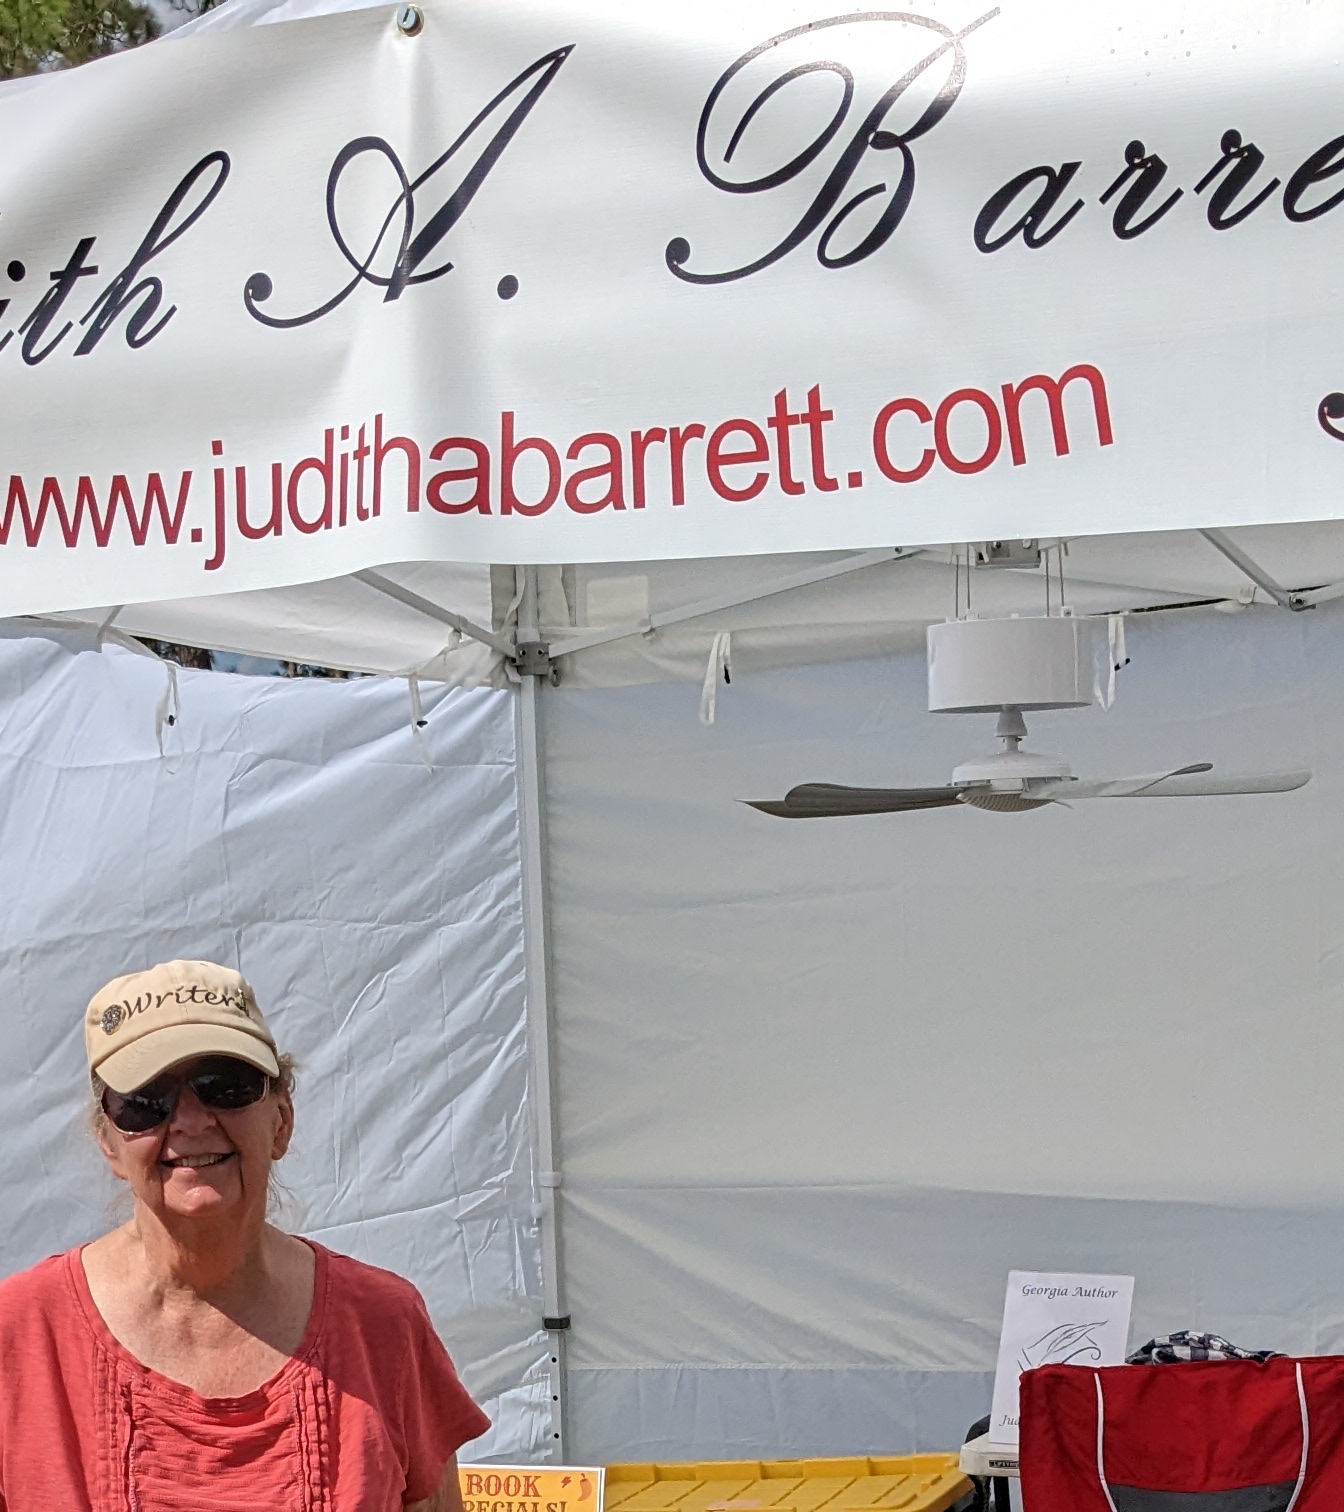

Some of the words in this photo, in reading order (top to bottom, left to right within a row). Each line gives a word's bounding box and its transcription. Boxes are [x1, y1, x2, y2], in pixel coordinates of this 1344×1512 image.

[243, 43, 577, 329] A.
[123, 985, 236, 1021] Writer
[1022, 1285, 1068, 1299] Georgia
[1072, 1286, 1118, 1298] Author
[464, 1474, 542, 1498] BOOK
